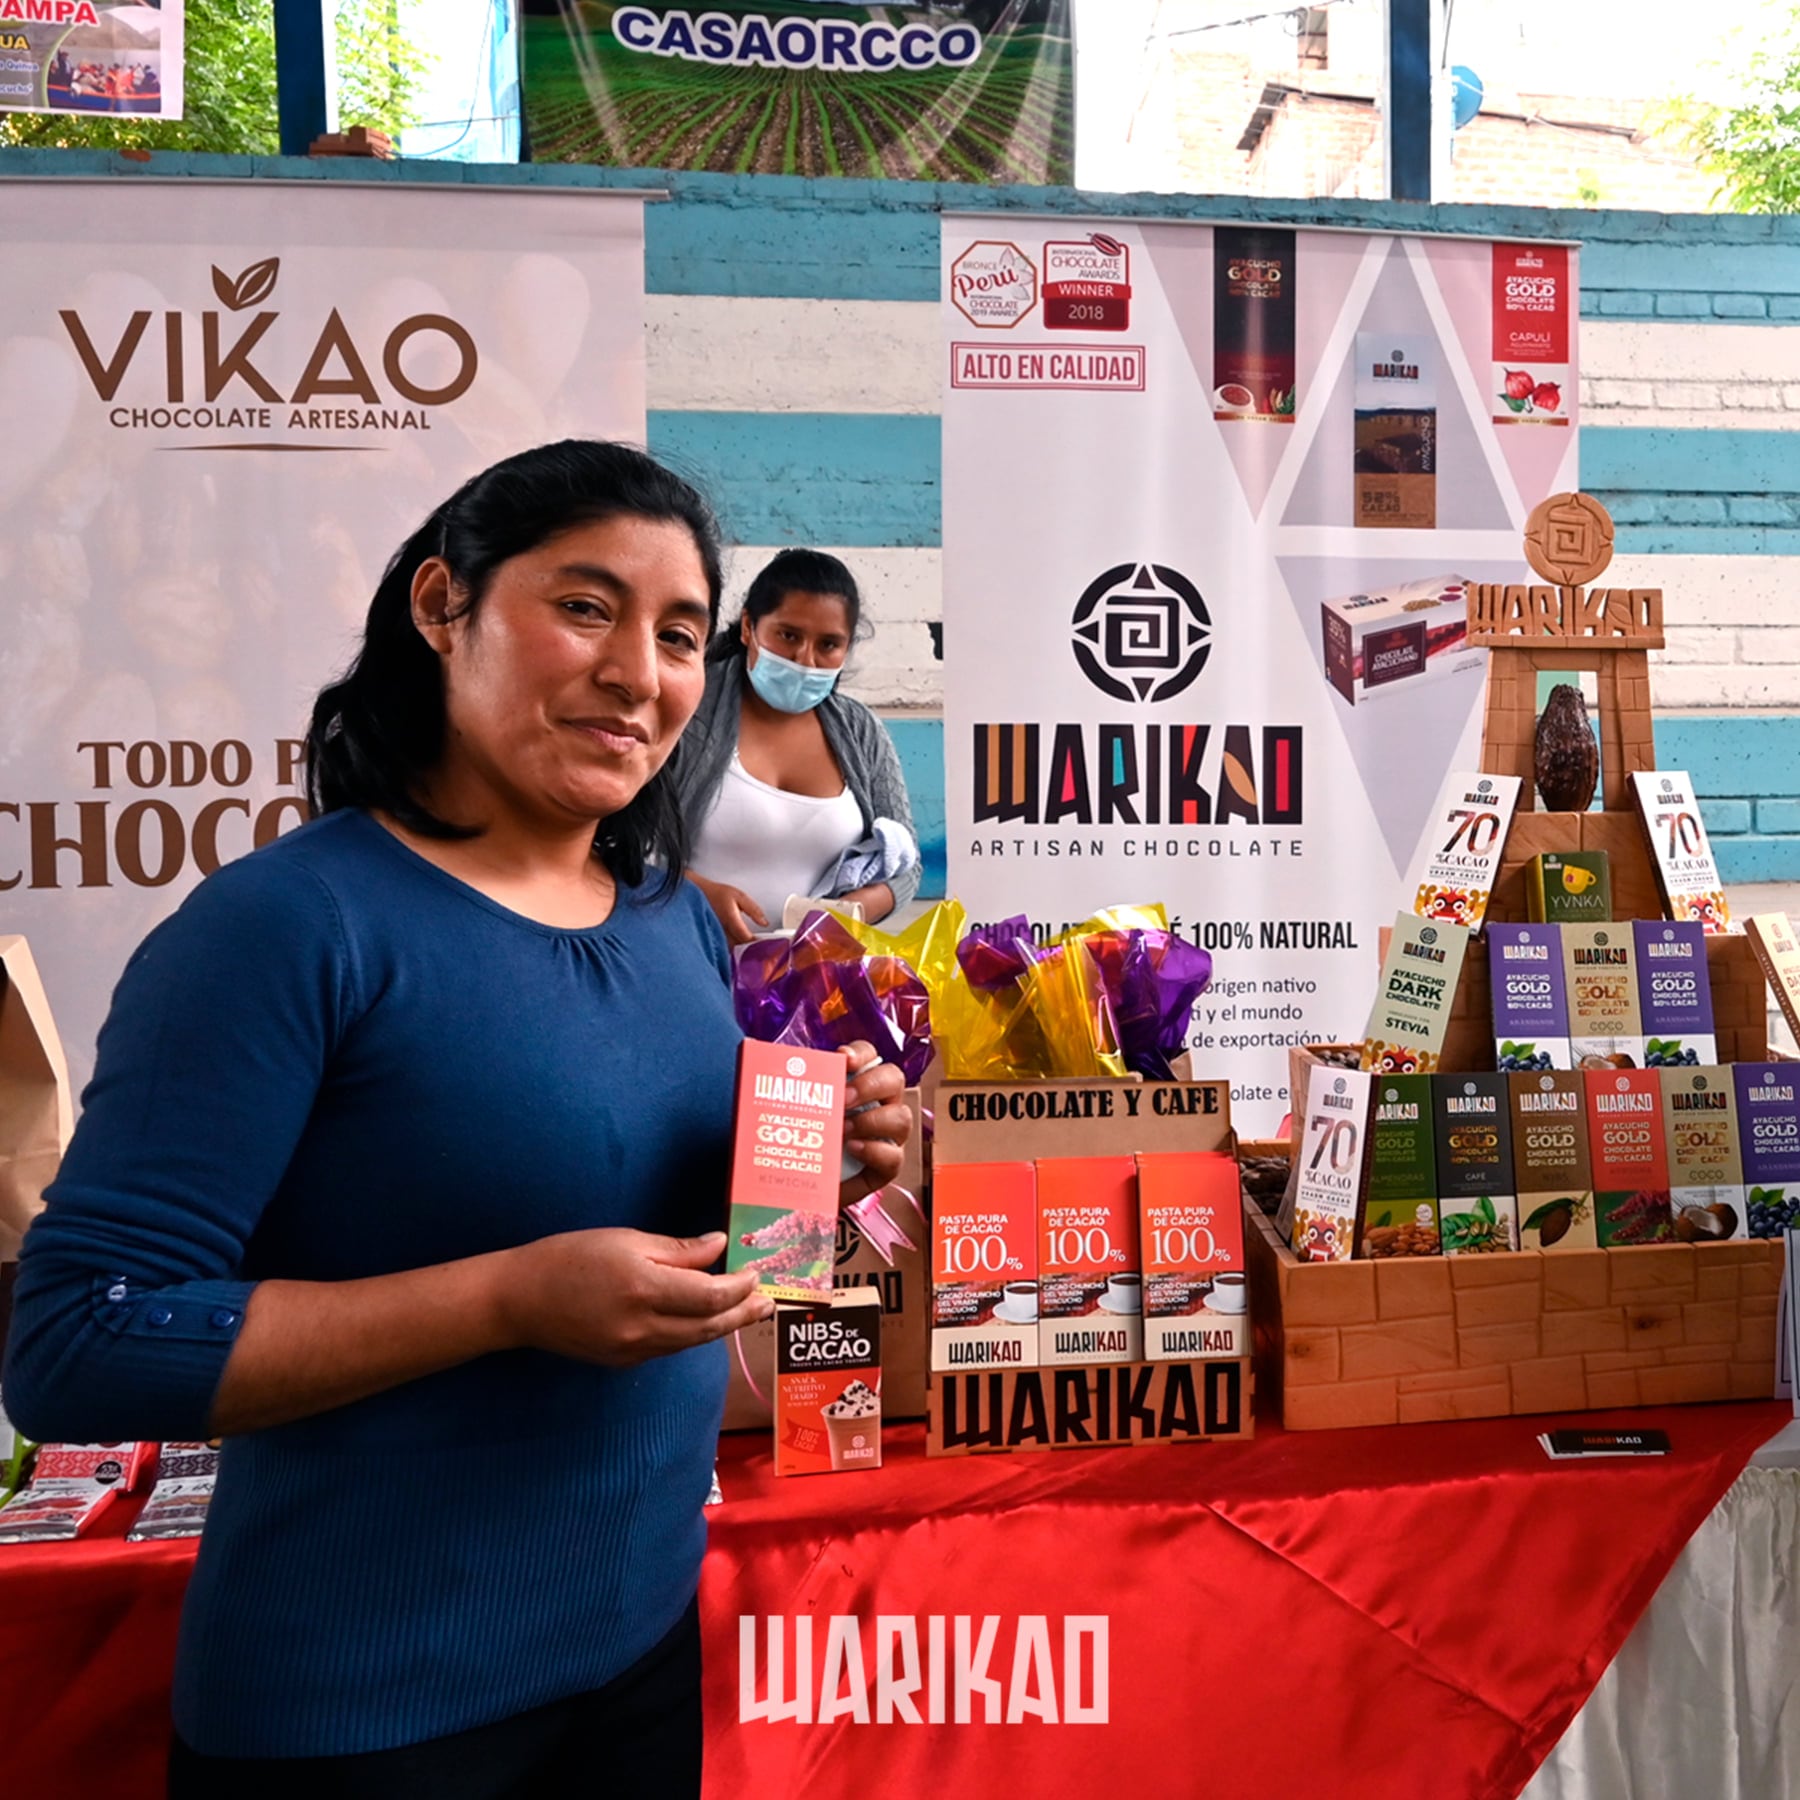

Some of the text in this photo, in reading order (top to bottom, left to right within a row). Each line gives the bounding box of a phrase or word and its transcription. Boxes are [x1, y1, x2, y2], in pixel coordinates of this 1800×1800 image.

[0, 0, 98, 25] AMPA
[615, 11, 979, 66] CASAORCCO
[1051, 256, 1120, 270] CHOCOLATE
[1078, 269, 1121, 280] AWARDS
[1227, 267, 1282, 282] GOLD
[1505, 275, 1555, 286] AYACUCHO
[1059, 284, 1114, 297] WINNER
[1505, 284, 1556, 298] GOLD
[969, 300, 1019, 310] CHOCOLATE
[1505, 297, 1555, 305] CHOCOLATE
[1527, 304, 1555, 312] CACAO
[1068, 304, 1104, 320] 2018
[58, 306, 478, 406] VIKAO
[963, 353, 1136, 381] ALTO EN CALIDAD
[110, 407, 432, 431] CHOCOLATE ARTESANAL
[1467, 583, 1664, 637] WARIKAO
[76, 739, 253, 789] TODO
[972, 722, 1303, 825] WARIKAO
[1442, 809, 1501, 857] 70
[1655, 812, 1704, 860] 70
[971, 840, 1304, 857] ARTISAN CHOCOLATE
[1190, 921, 1254, 950] 100%
[1258, 920, 1359, 950] NATURAL
[1402, 942, 1447, 964] WARIKAO
[1503, 945, 1548, 961] WARIKAO
[1574, 948, 1628, 965] WARIKAO
[1647, 943, 1693, 958] WARIKAO
[1392, 968, 1447, 988] AYACUCHO
[1506, 974, 1551, 982] AYACUCHO
[1651, 971, 1696, 979] AYACUCHO
[1262, 977, 1317, 994] nativo
[1388, 977, 1443, 1002] DARK
[1506, 981, 1551, 994] GOLD
[1575, 985, 1627, 1000] GOLD
[1651, 979, 1696, 992] GOLD
[1385, 991, 1441, 1011] CHOCOLATE
[1652, 991, 1697, 999] CHOCOLATE
[1526, 1002, 1553, 1010] CACAO
[1672, 999, 1698, 1008] CACAO
[1206, 1007, 1217, 1024] y
[1221, 1004, 1236, 1021] el
[1241, 1004, 1303, 1021] mundo
[1384, 1017, 1430, 1037] STEVIA
[1589, 1021, 1624, 1032] COCO
[1192, 1031, 1322, 1050] de exportación
[754, 1074, 834, 1109] WARIKAO
[1230, 1085, 1273, 1101] olate
[1748, 1086, 1794, 1102] WARIKAO
[948, 1087, 1219, 1122] CHOCOLATE Y CAFE
[1446, 1096, 1496, 1114] WARIKAO
[1519, 1092, 1578, 1112] WARIKAO
[1596, 1092, 1653, 1113] WARIKAO
[1672, 1092, 1727, 1111] WARIKAO
[1376, 1103, 1419, 1121] ARIKAO
[1752, 1115, 1797, 1124] AYACUCHO
[758, 1113, 825, 1132] AYACUCHO
[1525, 1125, 1574, 1134] AYACUCHO
[1602, 1122, 1650, 1130] AYACUCHO
[1674, 1122, 1728, 1132] AYACUCHO
[756, 1125, 825, 1149] GOLD
[1603, 1131, 1651, 1144] GOLD
[1753, 1125, 1798, 1137] GOLD
[1309, 1114, 1358, 1176] 70
[1376, 1138, 1415, 1149] GOLD
[1448, 1135, 1498, 1148] GOLD
[1526, 1134, 1575, 1148] GOLD
[1675, 1132, 1728, 1147] GOLD
[754, 1145, 823, 1163] CHOCOLATE
[1526, 1149, 1576, 1157] CHOCOLATE
[1603, 1145, 1652, 1153] CHOCOLATE
[1772, 1145, 1800, 1154] CACAO
[1548, 1157, 1577, 1166] CACAO
[1624, 1154, 1653, 1162] CACAO
[781, 1159, 822, 1175] CACAO
[758, 1174, 818, 1191] KIWICHA
[1689, 1169, 1724, 1181] COCO
[1043, 1207, 1110, 1218] PASTA PURA
[1147, 1206, 1215, 1217] PASTA PURA
[939, 1214, 1009, 1225] PASTA PURA
[1048, 1216, 1105, 1227] DE CACAO
[1153, 1216, 1210, 1226] DE CACAO
[945, 1225, 1003, 1235] DE CACAO
[1044, 1227, 1127, 1266] 100%
[1150, 1227, 1231, 1266] 100%
[940, 1234, 1024, 1275] 100%
[1043, 1281, 1105, 1291] CACAO CHUNCHO
[1149, 1281, 1211, 1291] CACAO CHUNCHO
[937, 1290, 1001, 1300] CACAO CHUNCHO
[1043, 1290, 1059, 1298] DEL
[1043, 1296, 1084, 1305] AYACUCHO
[1149, 1290, 1164, 1298] DEL
[1149, 1296, 1189, 1304] AYACUCHO
[937, 1299, 952, 1307] DEL
[937, 1305, 978, 1314] AYACUCHO
[789, 1321, 859, 1343] NIBS DE
[1055, 1330, 1128, 1354] WARIKAO
[1162, 1330, 1234, 1353] WARIKAO
[789, 1338, 872, 1362] CACAO
[948, 1340, 1023, 1364] WARIKAO
[782, 1384, 826, 1393] NUTRITIVO
[790, 1377, 817, 1385] SNACK
[789, 1392, 819, 1401] DIARIO
[941, 1361, 1241, 1450] WARIKAO
[1583, 1436, 1642, 1445] WARIKAO
